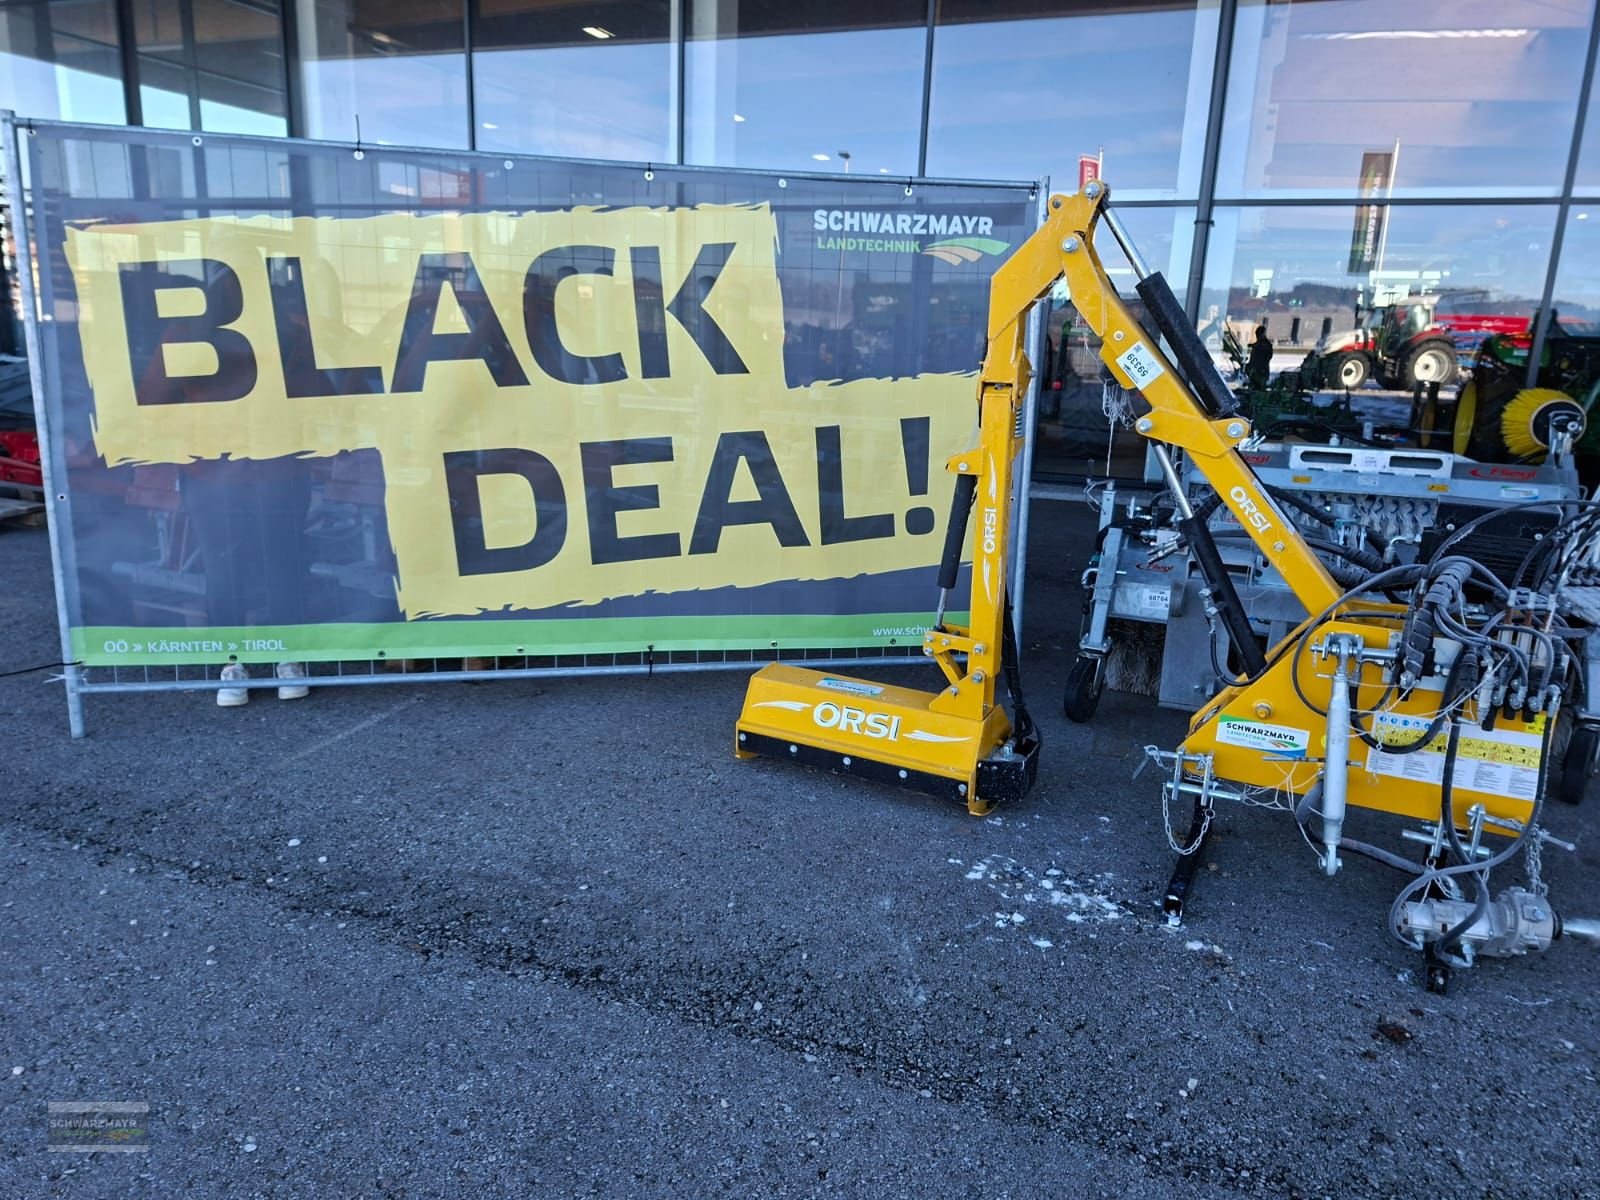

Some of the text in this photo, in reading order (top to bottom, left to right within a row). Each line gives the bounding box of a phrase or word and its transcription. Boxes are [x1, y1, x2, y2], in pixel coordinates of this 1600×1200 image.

[813, 209, 994, 236] SCHWARZMAYR
[817, 236, 921, 253] LANDTECHNIK
[117, 242, 750, 406] BLACK
[1126, 353, 1149, 378] 59339
[444, 416, 935, 577] DEAL!
[1230, 486, 1273, 534] ORSI
[983, 507, 997, 554] ORSI
[103, 638, 128, 653] OÖ
[147, 638, 223, 653] KÄRNTEN
[242, 639, 287, 651] TIROL
[812, 700, 902, 742] ORSI
[1226, 722, 1295, 742] SCHWARZMAYR
